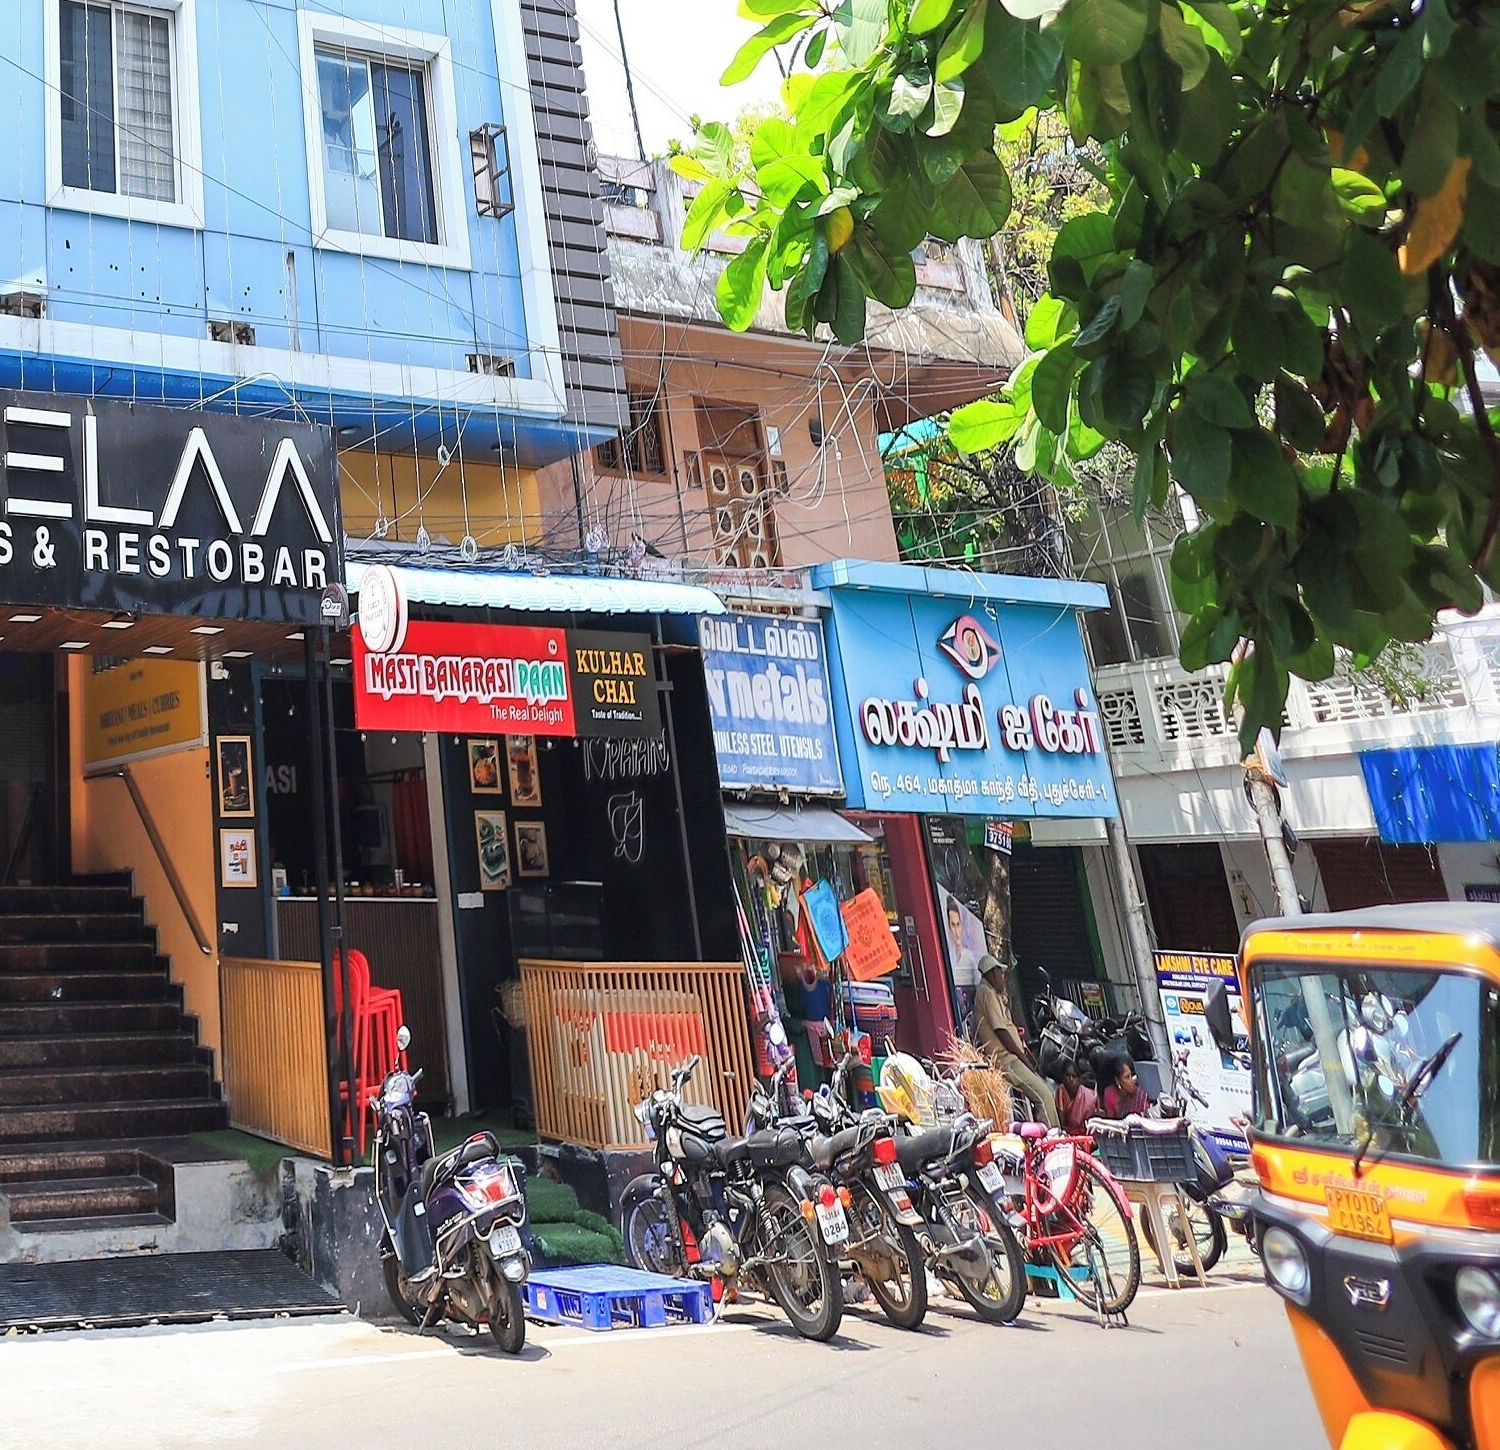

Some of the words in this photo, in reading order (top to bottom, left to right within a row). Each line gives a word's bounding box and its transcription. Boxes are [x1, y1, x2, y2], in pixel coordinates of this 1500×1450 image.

[32, 526, 57, 570] &
[85, 529, 328, 590] RESTOBAR
[700, 616, 818, 660] மெட்டல்ஸ்
[575, 649, 647, 676] KULHAR
[371, 657, 416, 689] MAST
[424, 661, 513, 694] BANARASI
[518, 662, 566, 697] PAAN
[593, 678, 636, 704] CHAI
[490, 704, 508, 720] The
[510, 707, 530, 721] Real
[532, 706, 564, 726] Delight
[750, 734, 778, 756] STEEL
[780, 735, 823, 760] UTENSILS
[927, 774, 978, 801] மகாத்மா
[981, 774, 1014, 803] காந்தி
[1155, 954, 1192, 973] LAKSHMI
[1192, 956, 1211, 974] EYE
[1210, 958, 1235, 977] CARE
[824, 1219, 847, 1238] 0284
